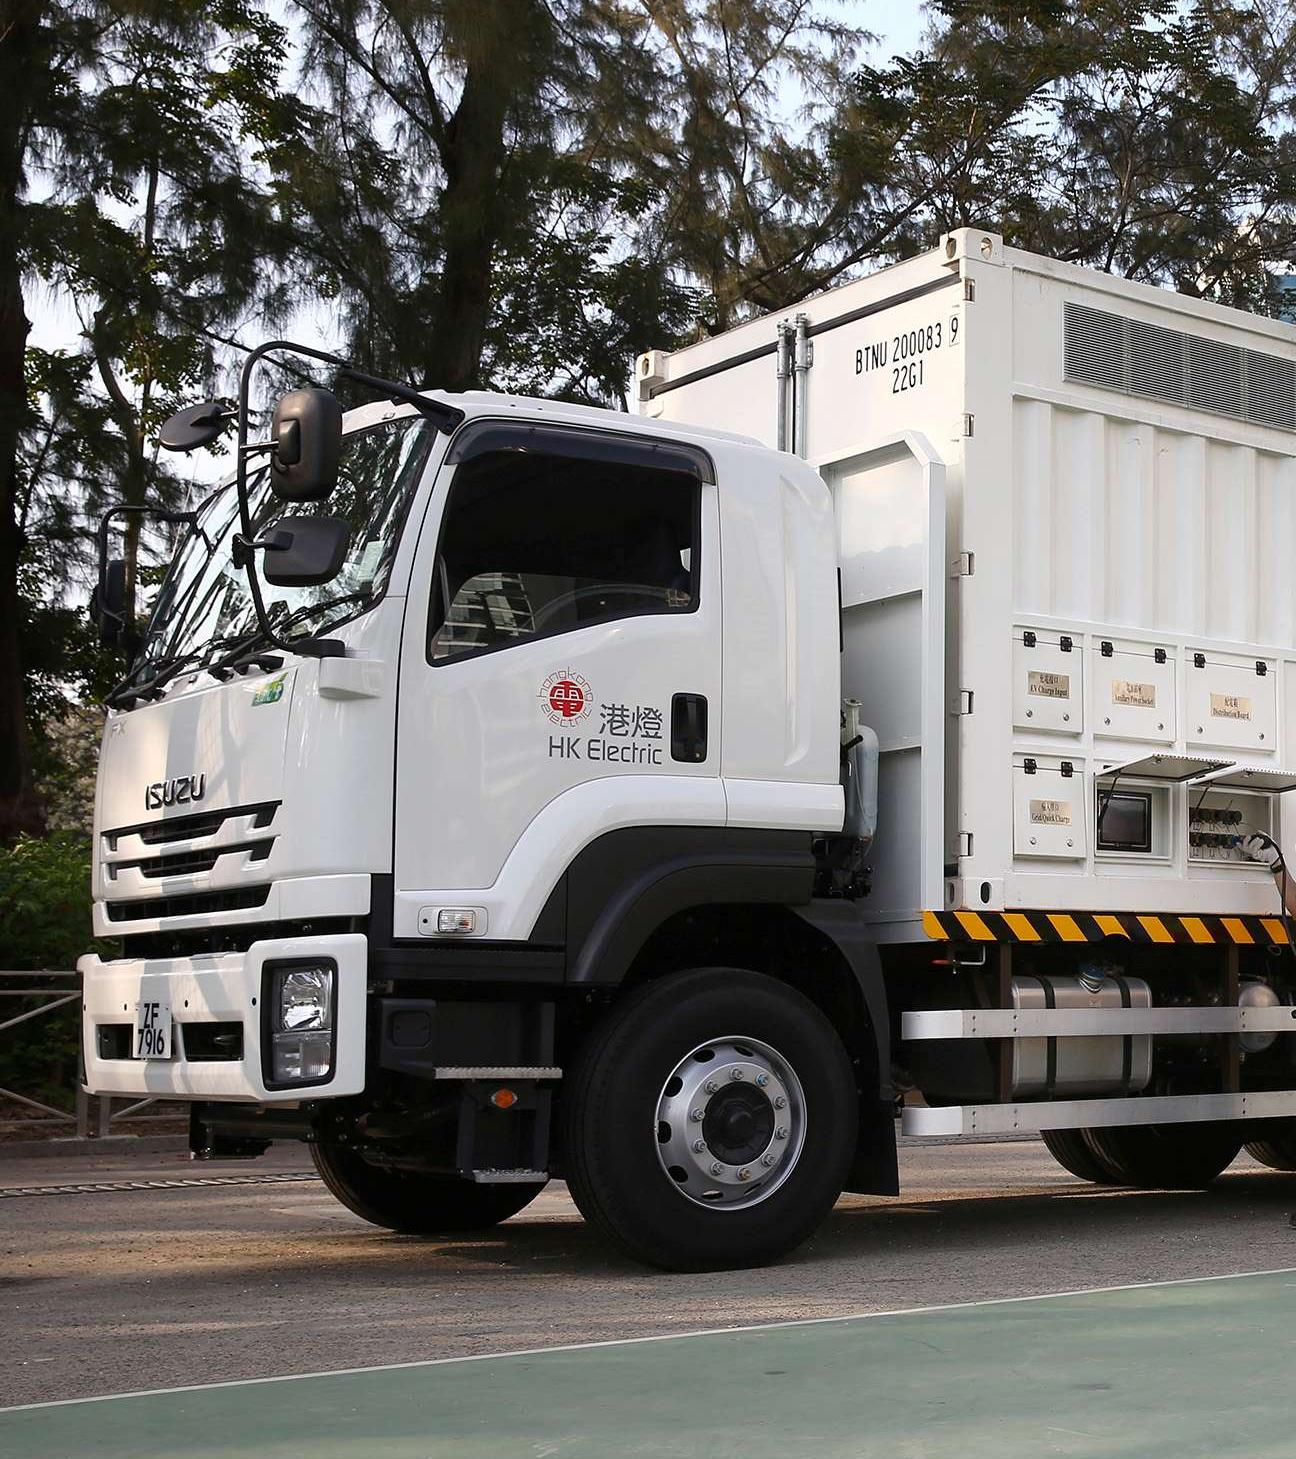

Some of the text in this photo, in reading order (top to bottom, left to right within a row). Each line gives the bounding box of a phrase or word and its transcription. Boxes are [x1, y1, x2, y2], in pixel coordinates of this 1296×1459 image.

[856, 317, 959, 375] BTNU 200083 9
[893, 360, 923, 394] 22G1
[599, 703, 663, 740] 港燈
[548, 735, 663, 765] HK Electric
[145, 772, 207, 811] ISUZU
[143, 1002, 160, 1029] ZF
[138, 1028, 165, 1055] 7916
